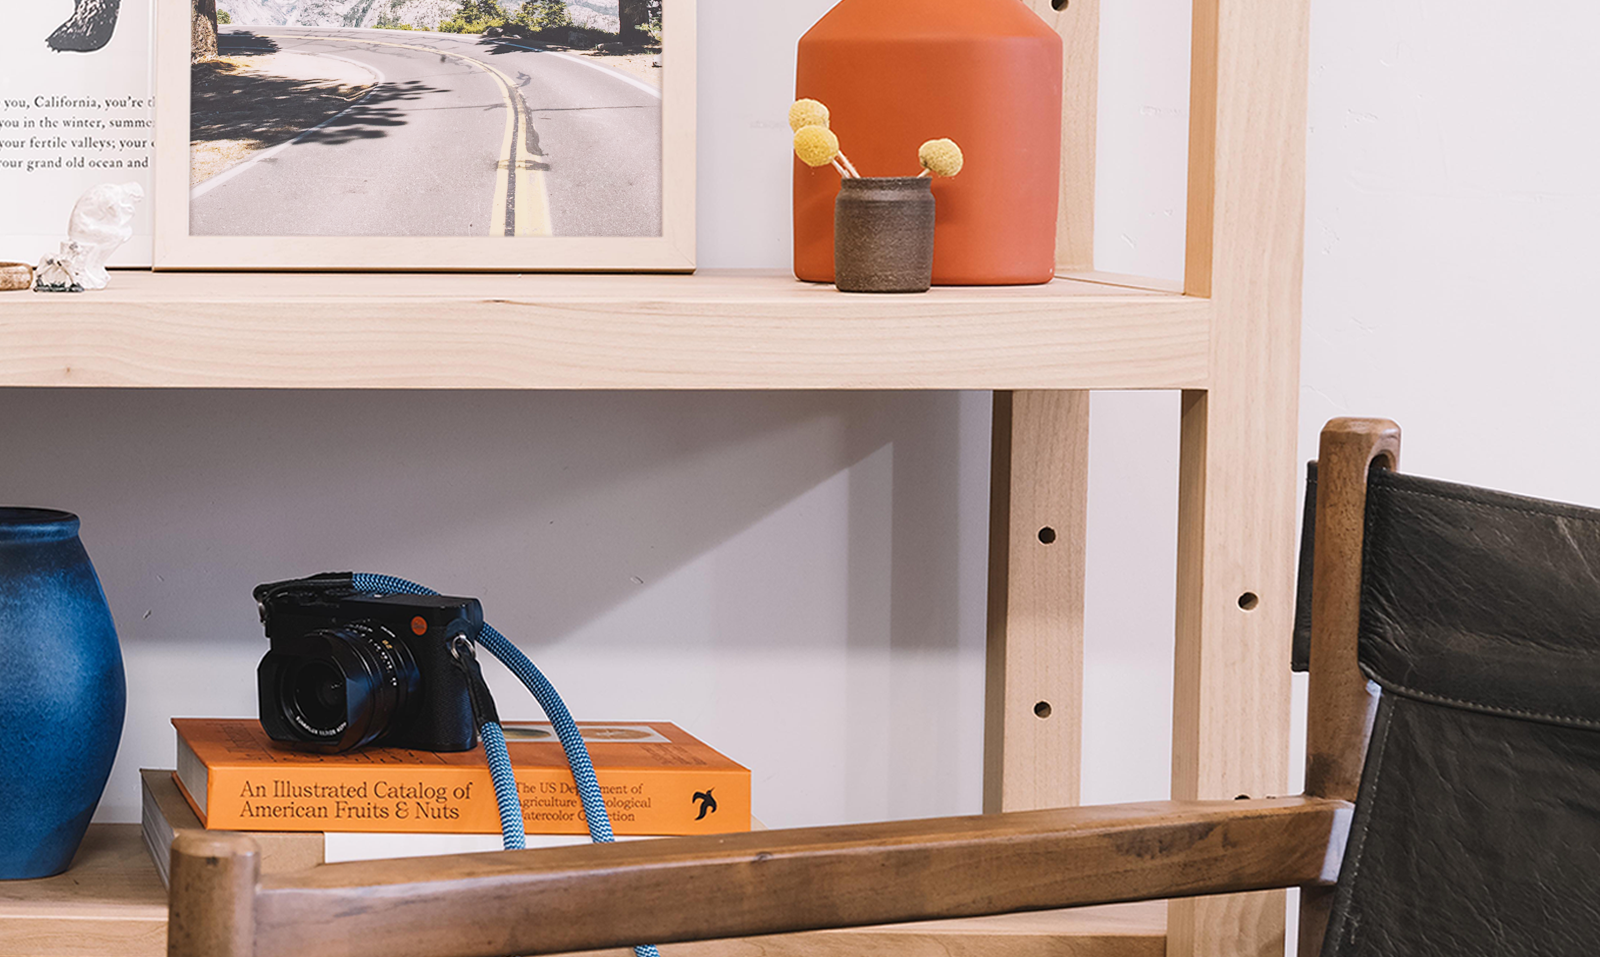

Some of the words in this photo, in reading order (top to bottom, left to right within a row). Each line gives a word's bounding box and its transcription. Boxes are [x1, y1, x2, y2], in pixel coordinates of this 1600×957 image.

[4, 99, 31, 111] you,
[33, 95, 102, 110] California,
[23, 116, 36, 128] in
[39, 116, 59, 128] the
[62, 116, 106, 130] winter,
[29, 136, 68, 148] fertile
[71, 136, 116, 152] valleys;
[119, 140, 148, 152] your
[26, 156, 63, 172] grand
[65, 156, 85, 168] old
[88, 159, 124, 168] ocean
[126, 156, 149, 168] and
[240, 780, 267, 798] An
[273, 779, 368, 799] Illustrated
[373, 781, 448, 803] Catalog
[453, 781, 474, 799] of
[540, 782, 557, 793] US
[630, 783, 644, 794] of
[240, 800, 329, 819] American
[334, 800, 390, 819] Fruits
[394, 802, 410, 819] &
[414, 801, 460, 819] Nuts
[522, 810, 575, 821] atercolor
